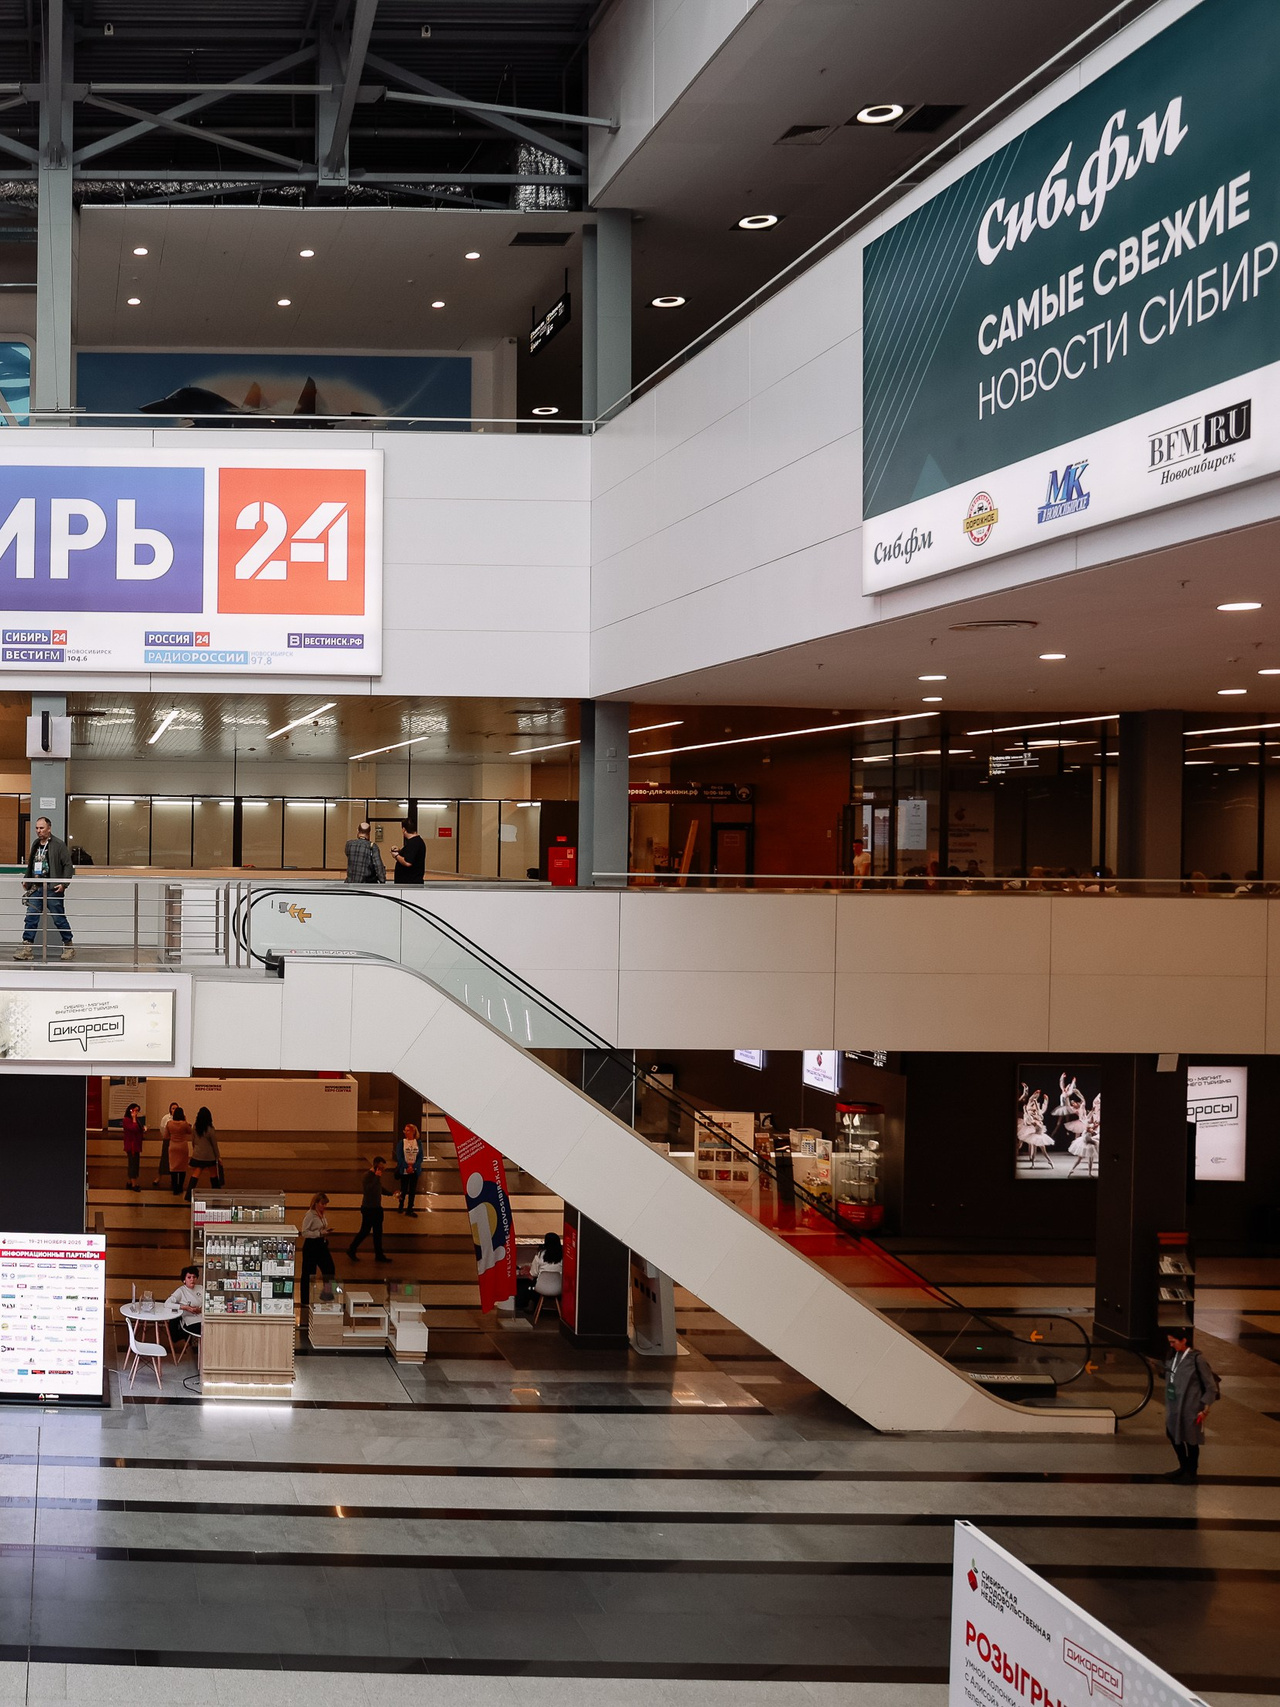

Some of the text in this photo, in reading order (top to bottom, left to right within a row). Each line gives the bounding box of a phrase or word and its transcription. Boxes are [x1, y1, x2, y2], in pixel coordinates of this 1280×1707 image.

[977, 96, 1188, 266] Сиб.фм
[978, 170, 1251, 356] САМЫЕ СВЕЖИЕ
[979, 311, 1128, 421] НОВОСТИ
[1160, 453, 1236, 485] Новосибирск
[966, 513, 995, 530] ДОРОЖНОЕ
[234, 501, 349, 581] 24
[873, 527, 933, 565] Сиб.фм
[5, 632, 66, 643] СИБИРЬ 24
[147, 633, 209, 645] РОССИЯ 24
[305, 636, 363, 647] ВЕСТИНСК.РФ
[5, 650, 61, 660] ВЕСТИFM
[251, 656, 273, 665] 97.8
[53, 1022, 119, 1036] ДИКОРОСЫ
[1187, 1103, 1233, 1116] ОРОСЫ
[1, 1250, 65, 1259] ИНФОРМАЦИОННЫЕ
[981, 1570, 1018, 1605] СИБИРСКАЯ
[980, 1589, 1004, 1614] НЕДЕЛЯ
[980, 1579, 1051, 1643] ПРОДОВОЛЬСТВЕННАЯ
[964, 1657, 986, 1681] умной
[966, 1620, 1068, 1707] РОЗЫГРЫ
[1067, 1648, 1119, 1689] ДИКОРОСЫ
